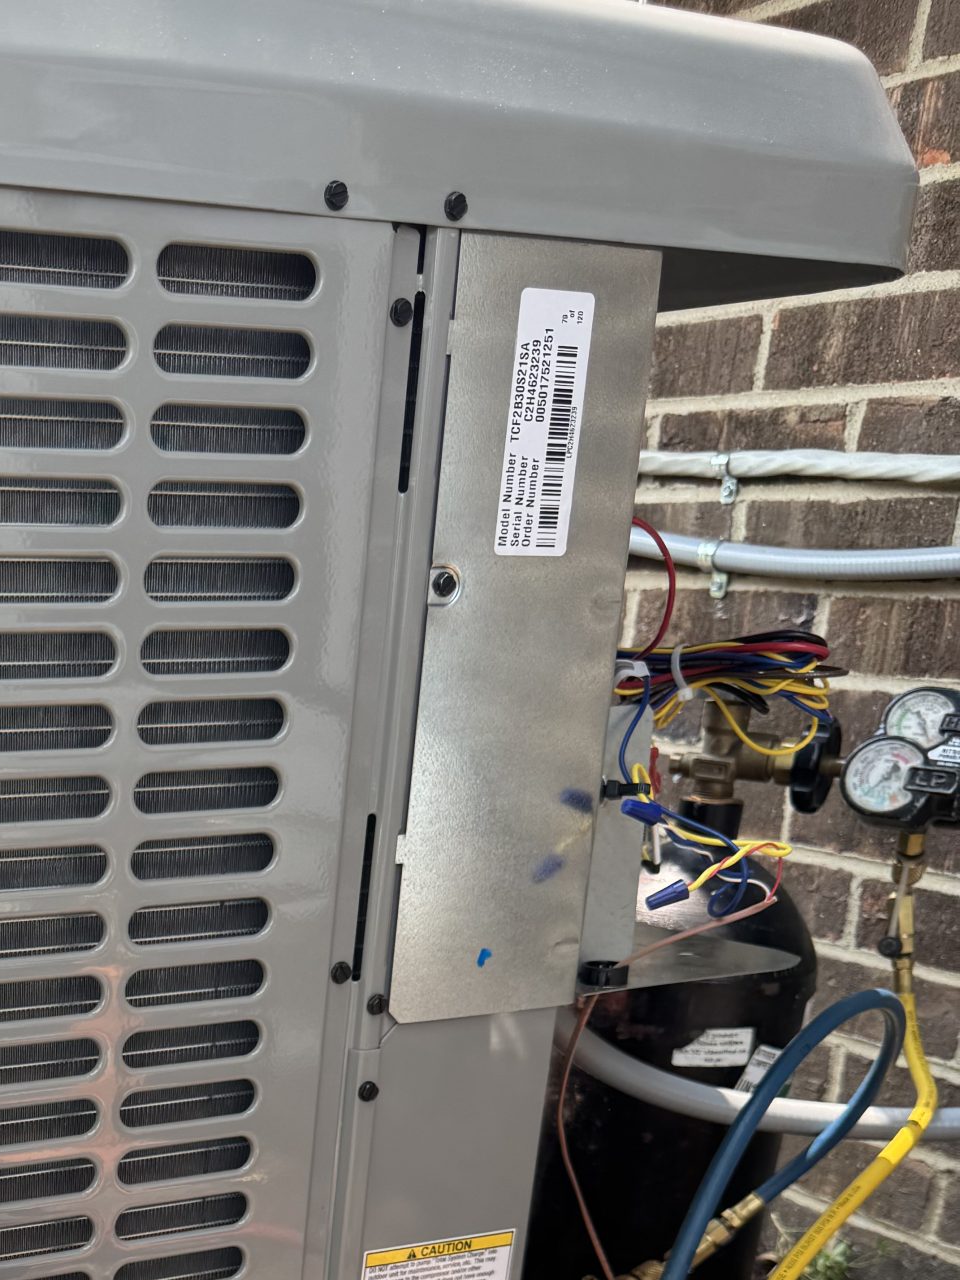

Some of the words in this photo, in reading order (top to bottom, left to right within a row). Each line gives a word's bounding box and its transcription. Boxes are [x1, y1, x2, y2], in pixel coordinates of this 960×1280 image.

[569, 310, 575, 318] of
[510, 342, 530, 443] TCF2B30S21SA
[524, 339, 541, 422] C2H4623239
[535, 328, 554, 423] 005017521251
[502, 452, 517, 503] Number
[514, 455, 529, 506] Number
[526, 458, 540, 508] Number
[498, 508, 511, 547] Model
[510, 511, 523, 547] Serial
[521, 513, 534, 547] Order
[915, 769, 947, 787] LP
[421, 1239, 472, 1257] CAUTION
